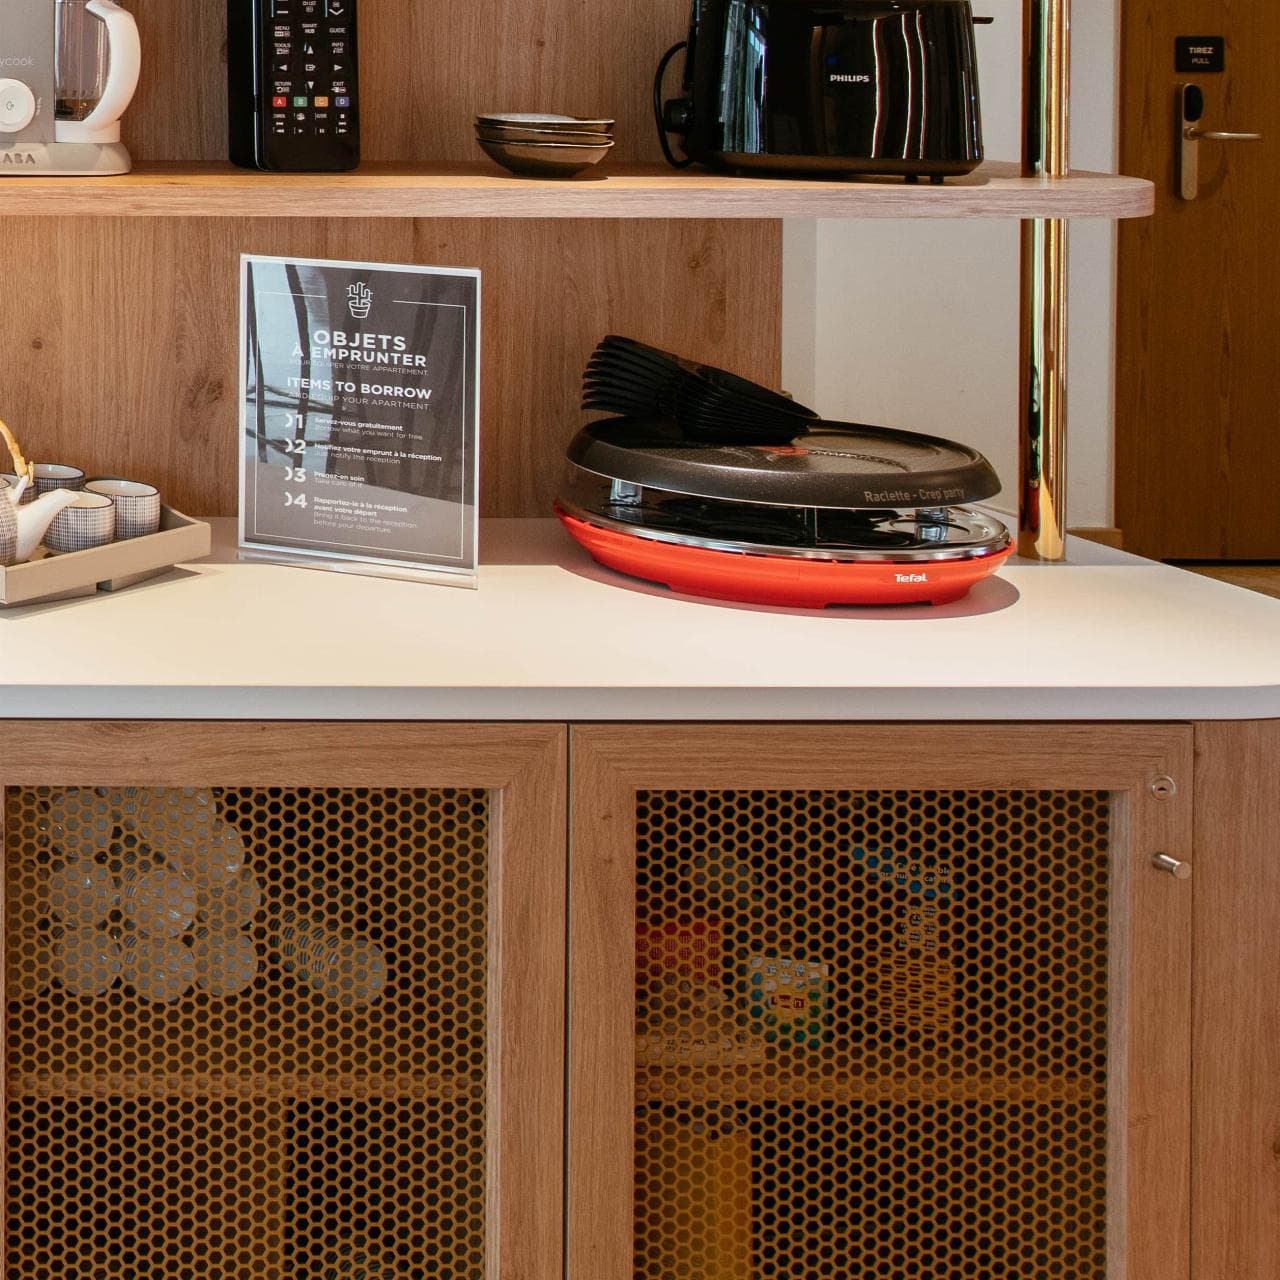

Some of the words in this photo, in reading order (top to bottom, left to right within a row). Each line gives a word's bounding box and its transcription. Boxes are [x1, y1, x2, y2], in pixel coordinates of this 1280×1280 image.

[313, 329, 406, 351] OBJETS
[292, 341, 304, 357] À
[311, 346, 427, 367] EMPRUNTER
[287, 376, 331, 390] ITEMS
[335, 381, 356, 393] TO
[360, 383, 432, 399] BORROW
[342, 397, 369, 405] YOUR
[357, 421, 403, 432] gratuitement
[362, 448, 392, 457] emprunt
[407, 452, 442, 462] réception
[864, 491, 910, 502] Raclette
[373, 503, 408, 513] réception
[895, 573, 928, 583] Tefal
